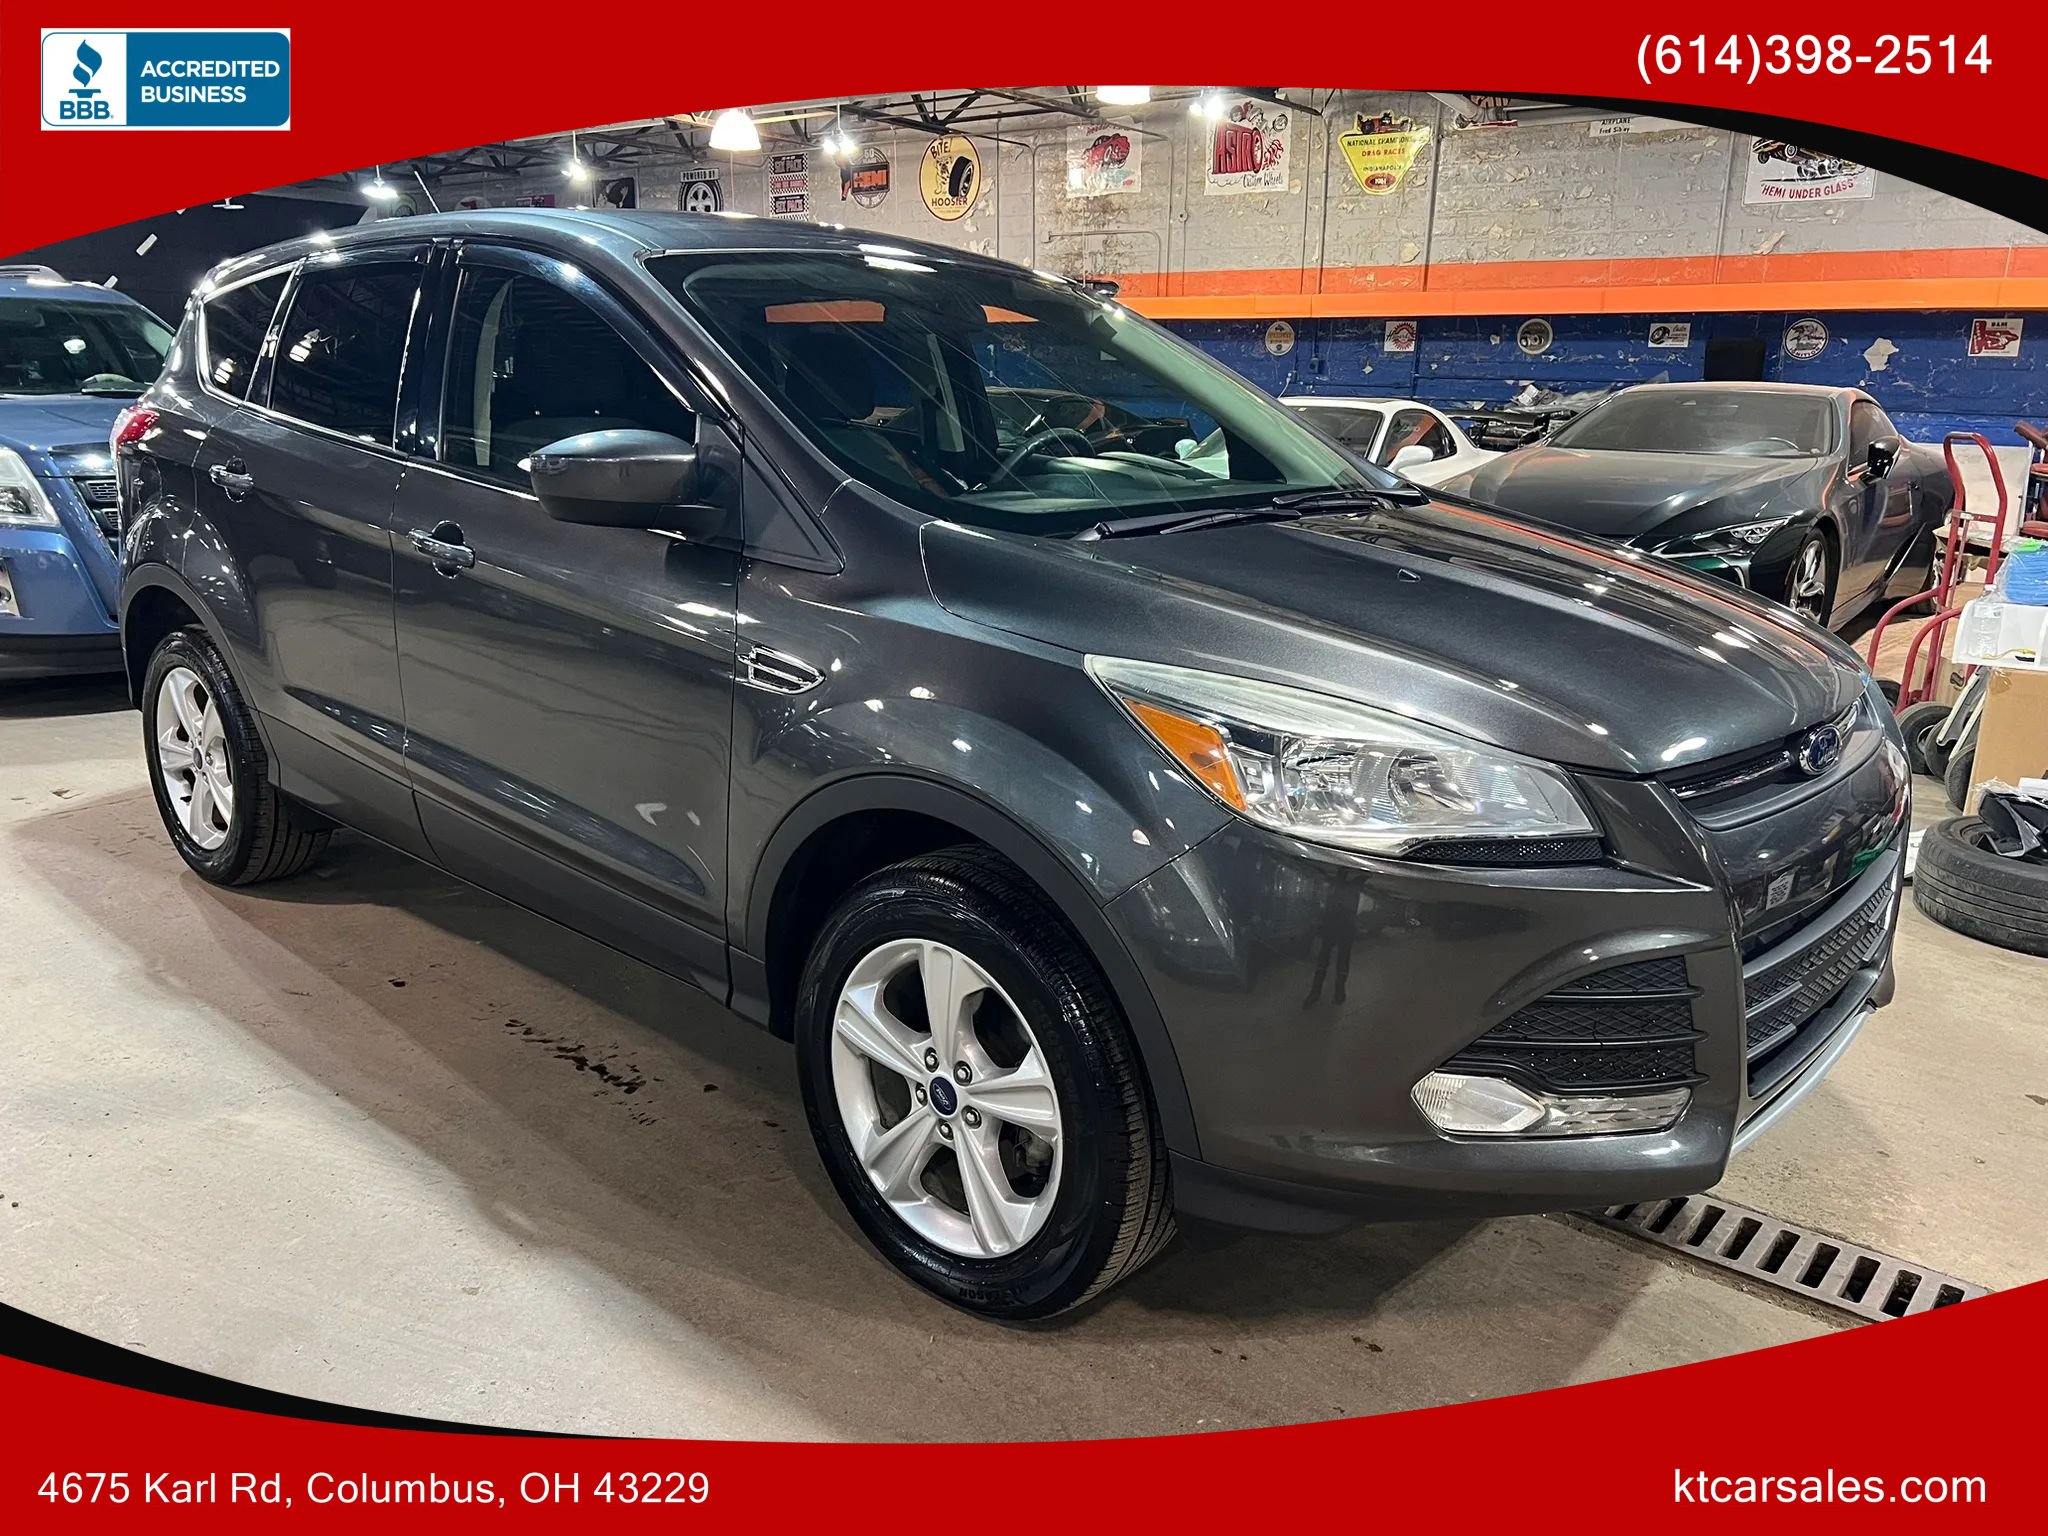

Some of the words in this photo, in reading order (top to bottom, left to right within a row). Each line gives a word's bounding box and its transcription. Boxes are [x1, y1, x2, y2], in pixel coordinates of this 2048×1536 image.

[1211, 121, 1264, 174] ASTRO
[1347, 138, 1376, 147] NATIONAL
[853, 169, 888, 189] HEMI
[1788, 187, 1822, 199] UNDER
[931, 197, 969, 207] HOOSIER
